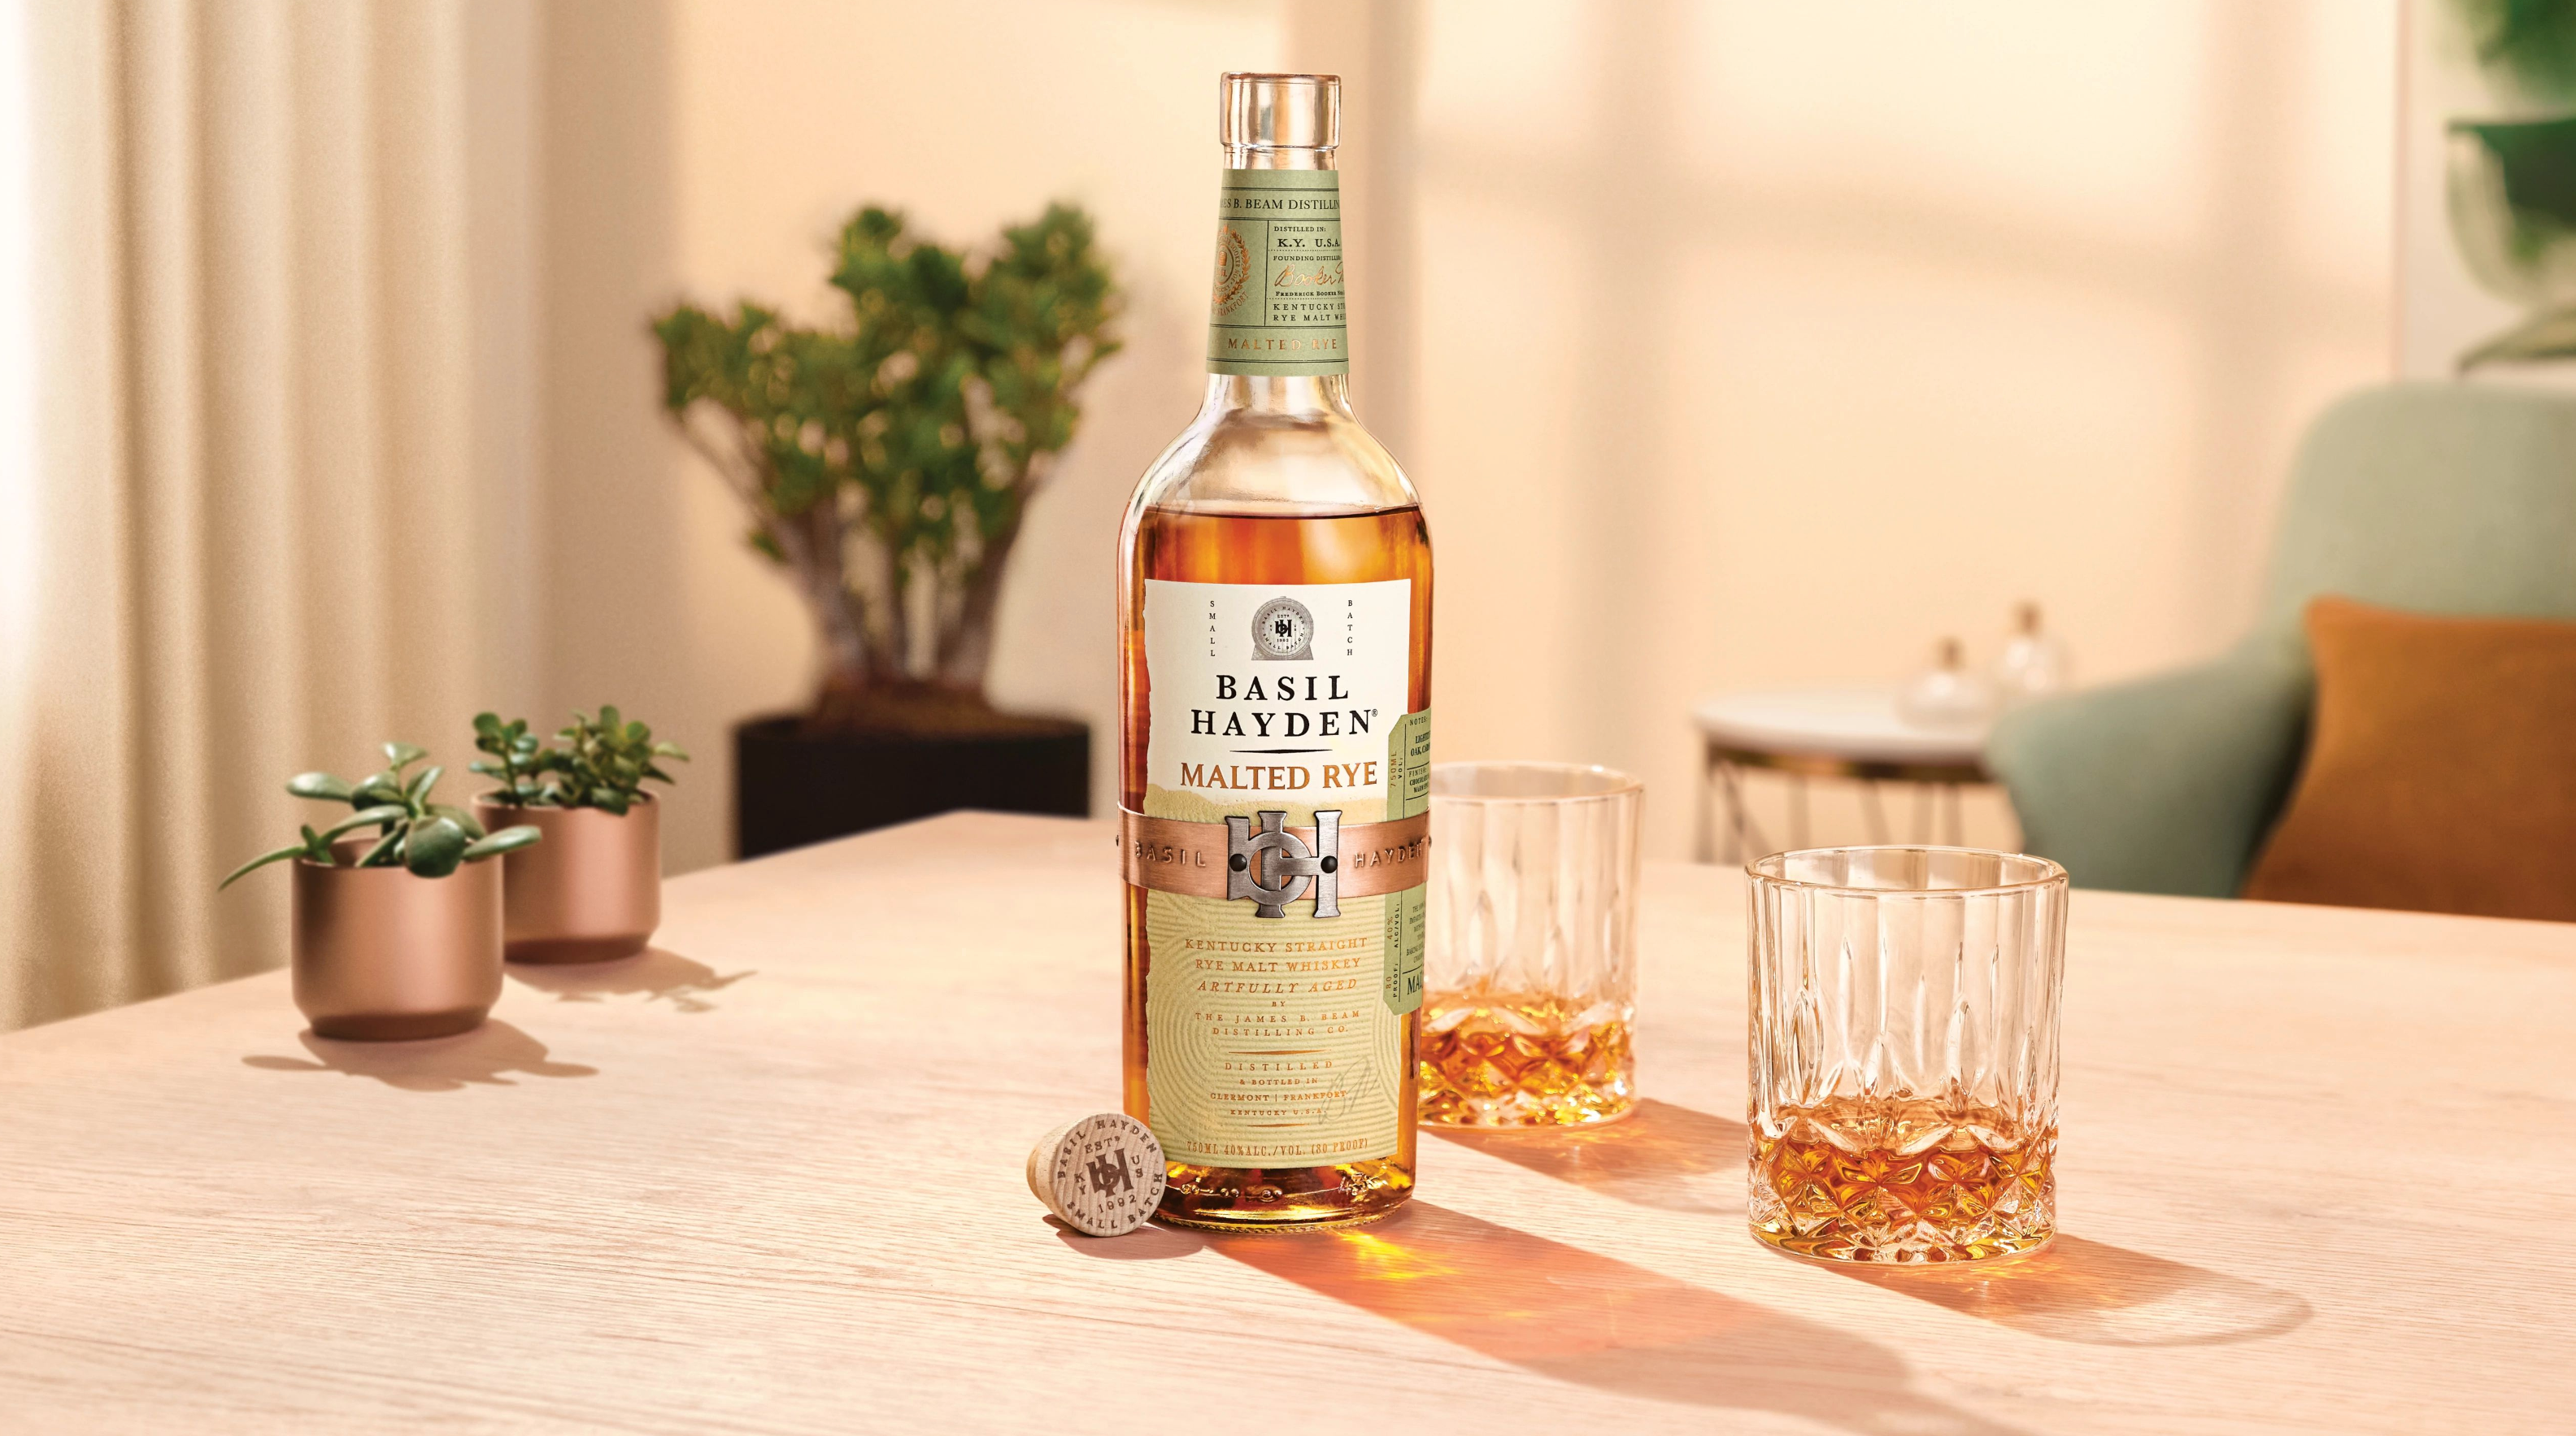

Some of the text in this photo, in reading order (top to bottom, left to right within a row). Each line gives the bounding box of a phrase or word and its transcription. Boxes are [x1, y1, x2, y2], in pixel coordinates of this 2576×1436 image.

[1234, 198, 1242, 209] B.
[1246, 198, 1283, 210] BEAM
[1277, 238, 1306, 248] K.Y.
[1228, 338, 1338, 350] MALTED RYE
[1208, 599, 1216, 657] SMALL
[1346, 598, 1354, 656] BATCH
[1216, 674, 1348, 701] BASIL
[1180, 760, 1377, 790] MALTED RYE
[1134, 840, 1207, 868] BASIL
[1185, 937, 1368, 953] KENTUCKY STRAIGHT
[1195, 957, 1361, 973] RYE MALT WHISKEY
[1197, 978, 1357, 994] ARTFULLY AGED
[1386, 976, 1392, 990] 80
[1195, 1010, 1360, 1024] THE JAMES B. BEAM
[1212, 1025, 1348, 1037] DISTILLING CO.
[1225, 1060, 1334, 1072] DISTILLED
[1210, 1092, 1269, 1102] CLERMONT
[1282, 1090, 1347, 1101] FRANKFORT
[1057, 1119, 1157, 1179] BASIL HAYDEN
[1186, 1141, 1219, 1155] 750ML
[1332, 1138, 1368, 1154] PROOF)
[1067, 1172, 1164, 1229] SMALL BATCH
[1098, 1194, 1137, 1214] 1992
